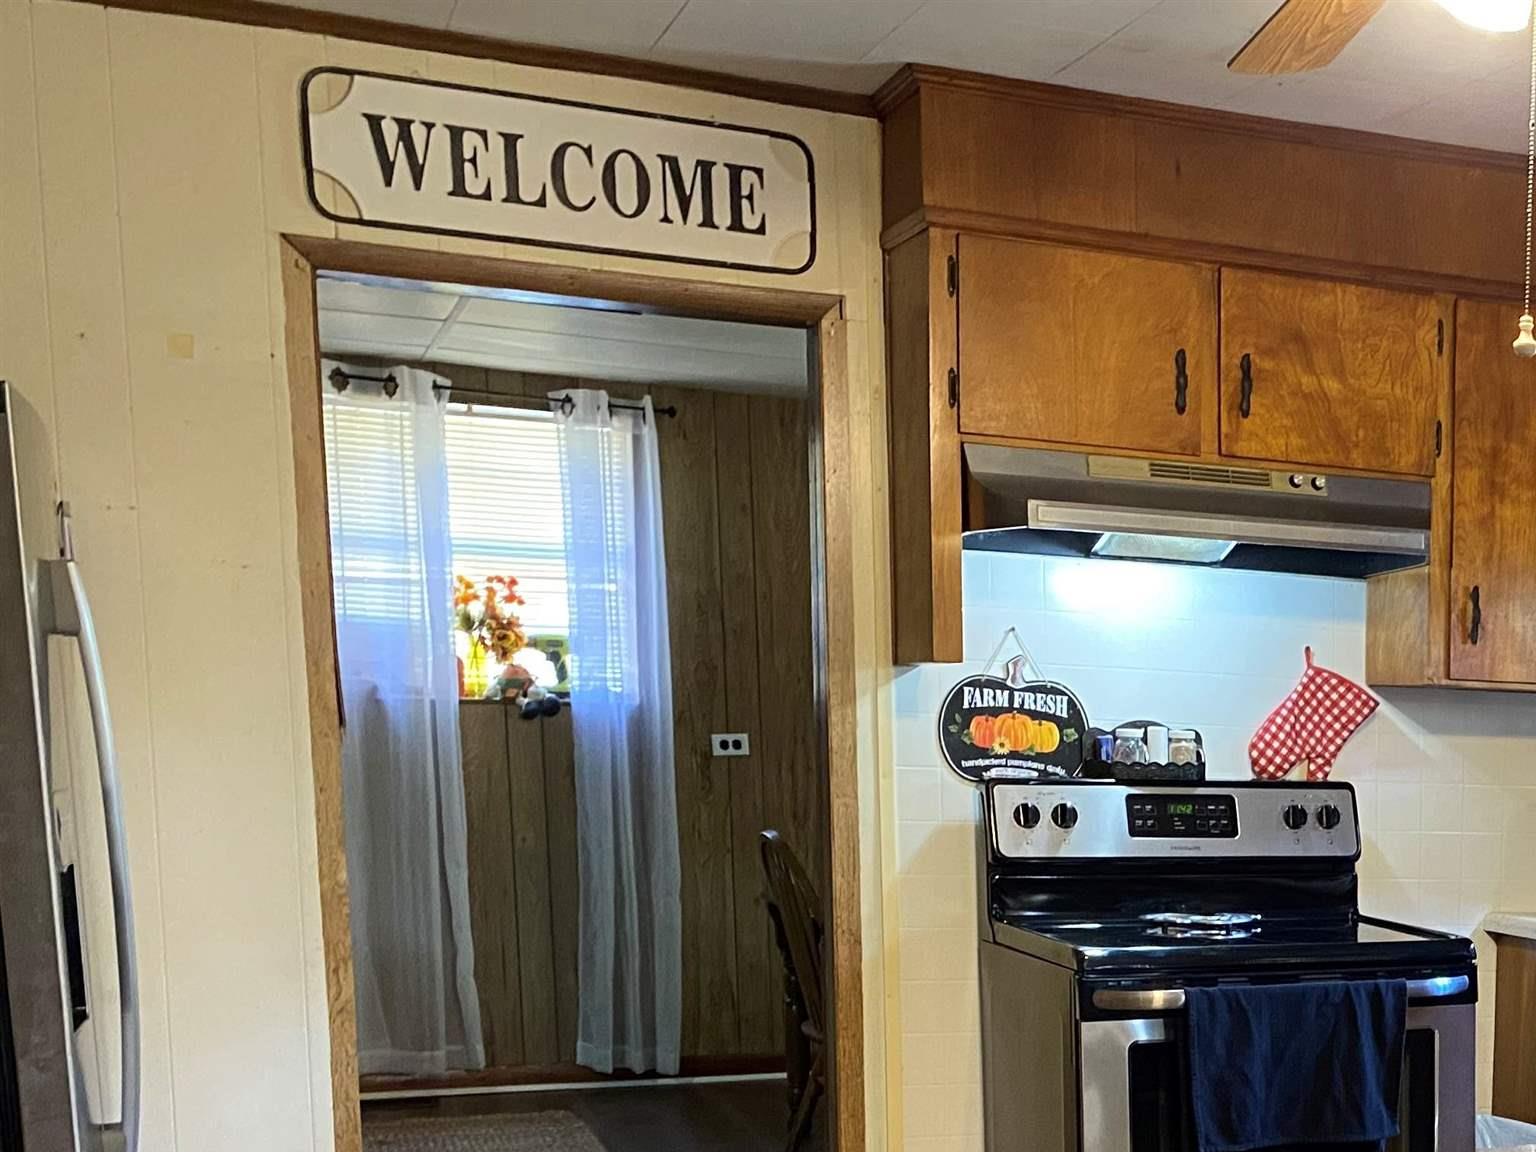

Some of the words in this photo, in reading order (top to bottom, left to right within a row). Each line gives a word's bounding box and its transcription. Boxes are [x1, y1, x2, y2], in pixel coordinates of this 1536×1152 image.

[361, 112, 767, 236] WELCOME
[962, 686, 1010, 709] FARM
[1013, 689, 1069, 719] FRESH
